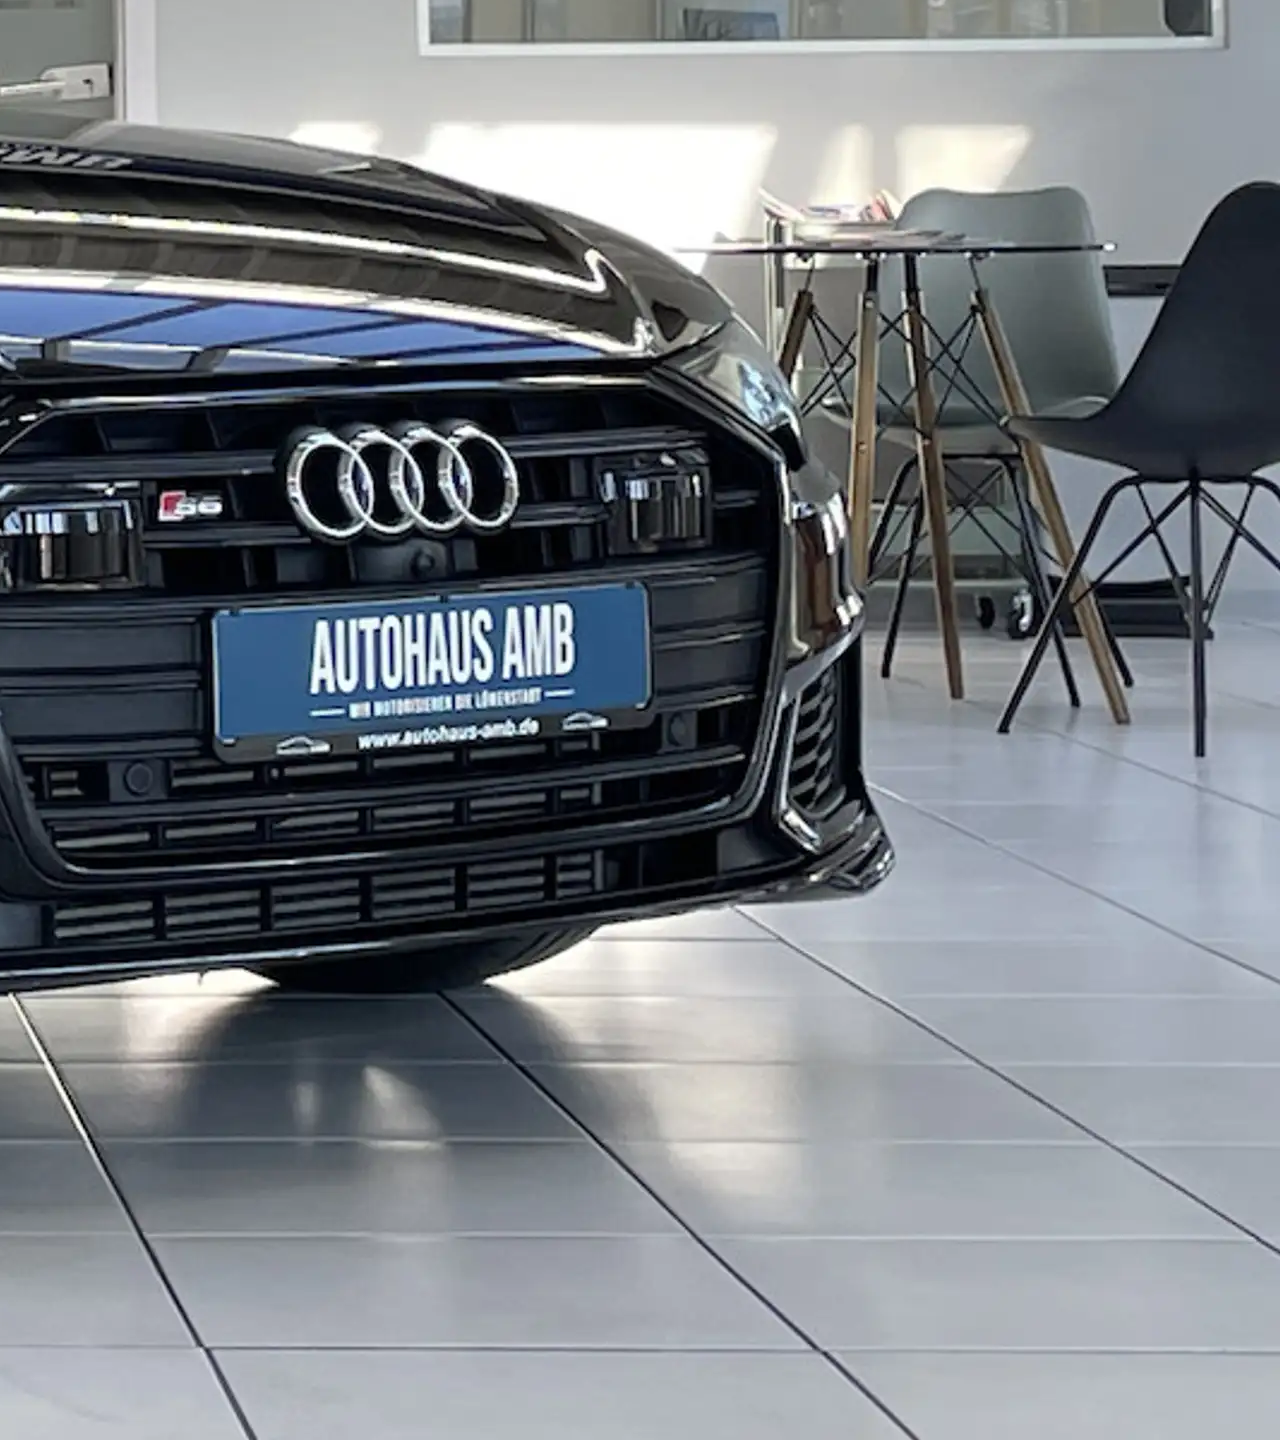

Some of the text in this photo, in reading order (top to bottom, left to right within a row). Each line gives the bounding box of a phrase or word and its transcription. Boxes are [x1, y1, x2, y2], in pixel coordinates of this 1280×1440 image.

[310, 604, 575, 694] AUTOHAUS AMB
[358, 717, 539, 749] www.autohaus-amb.de
